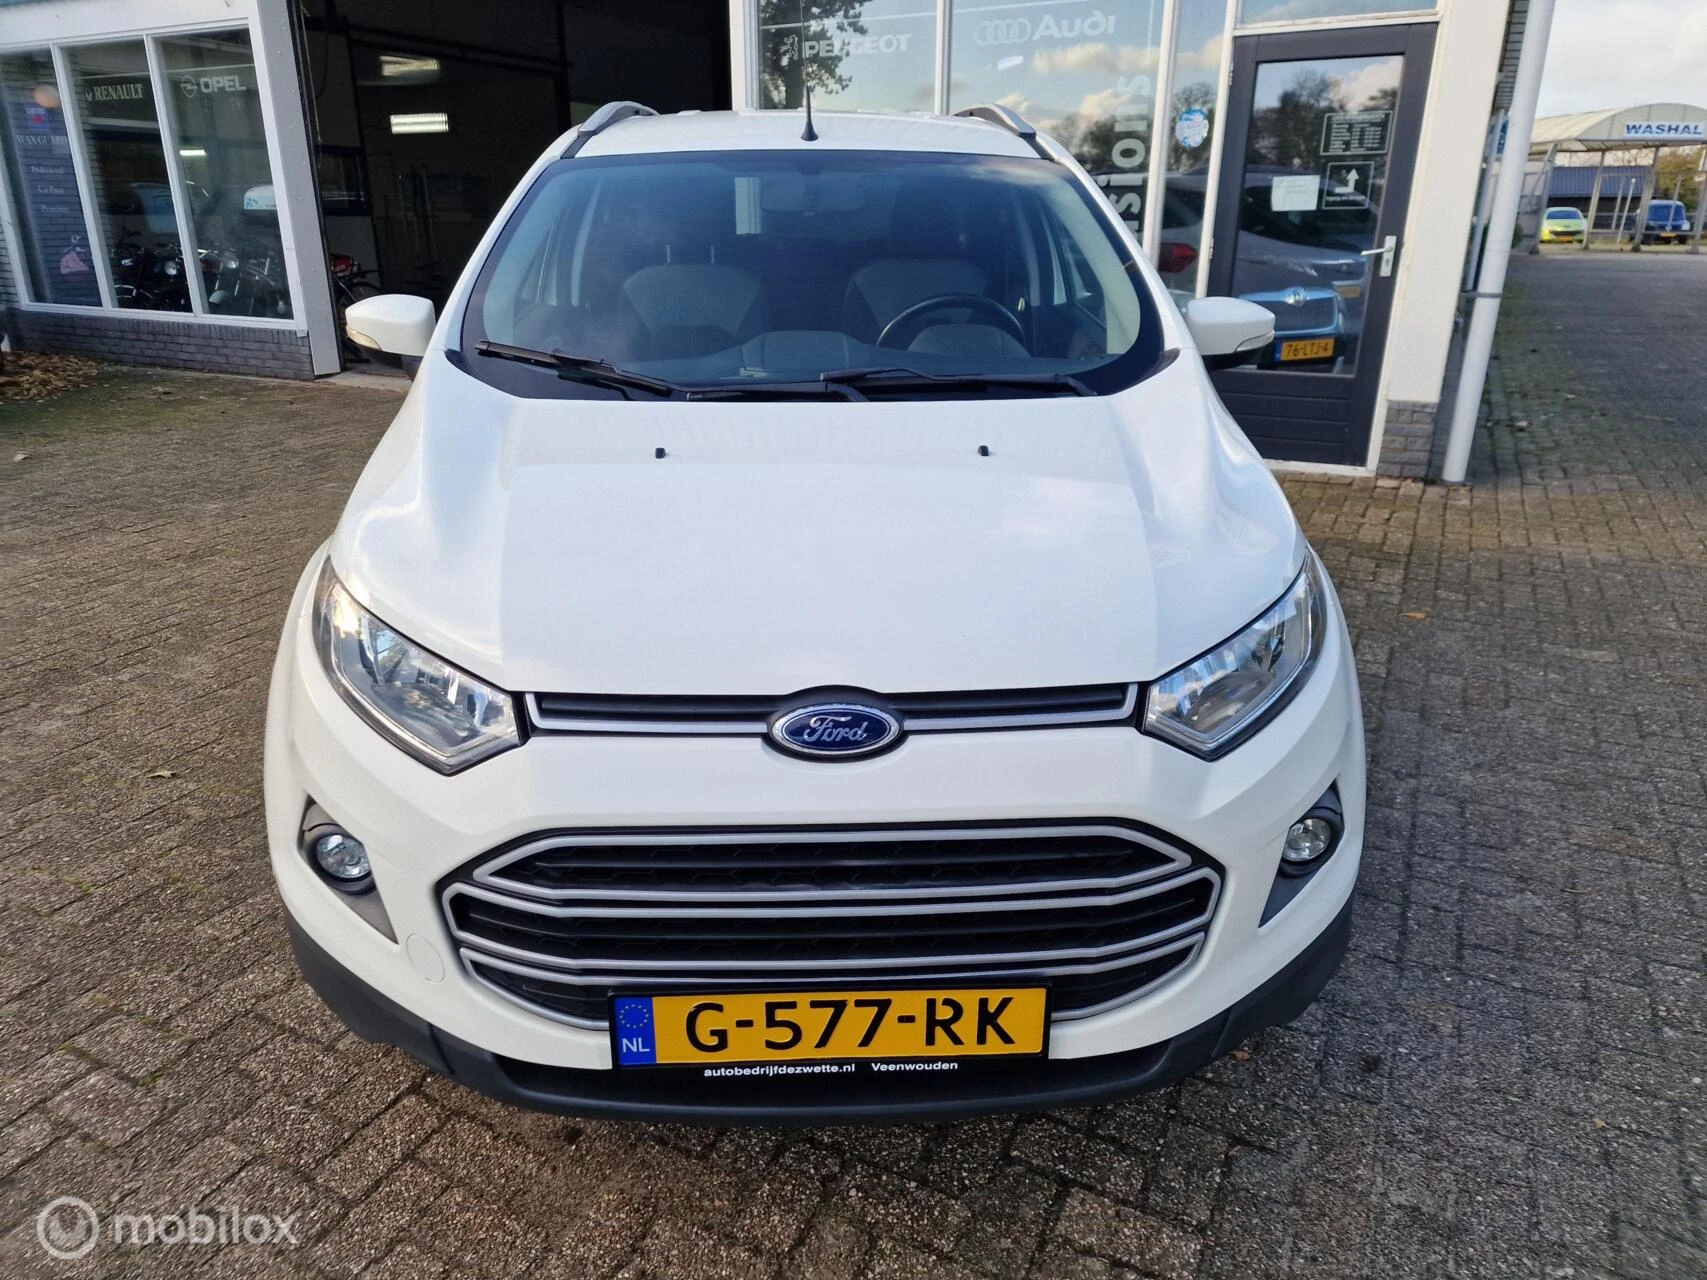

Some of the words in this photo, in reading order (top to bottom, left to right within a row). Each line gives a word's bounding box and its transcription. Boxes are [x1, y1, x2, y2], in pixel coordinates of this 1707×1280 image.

[93, 83, 144, 101] RENAULT
[199, 74, 247, 93] OPEL
[1626, 123, 1703, 135] WASHAL
[803, 715, 868, 742] Ford
[684, 996, 1016, 1053] G-577-RK
[621, 1037, 650, 1053] NL
[703, 1062, 856, 1078] autobedrijfdezwette.nl
[871, 1060, 959, 1072] Veenwouden
